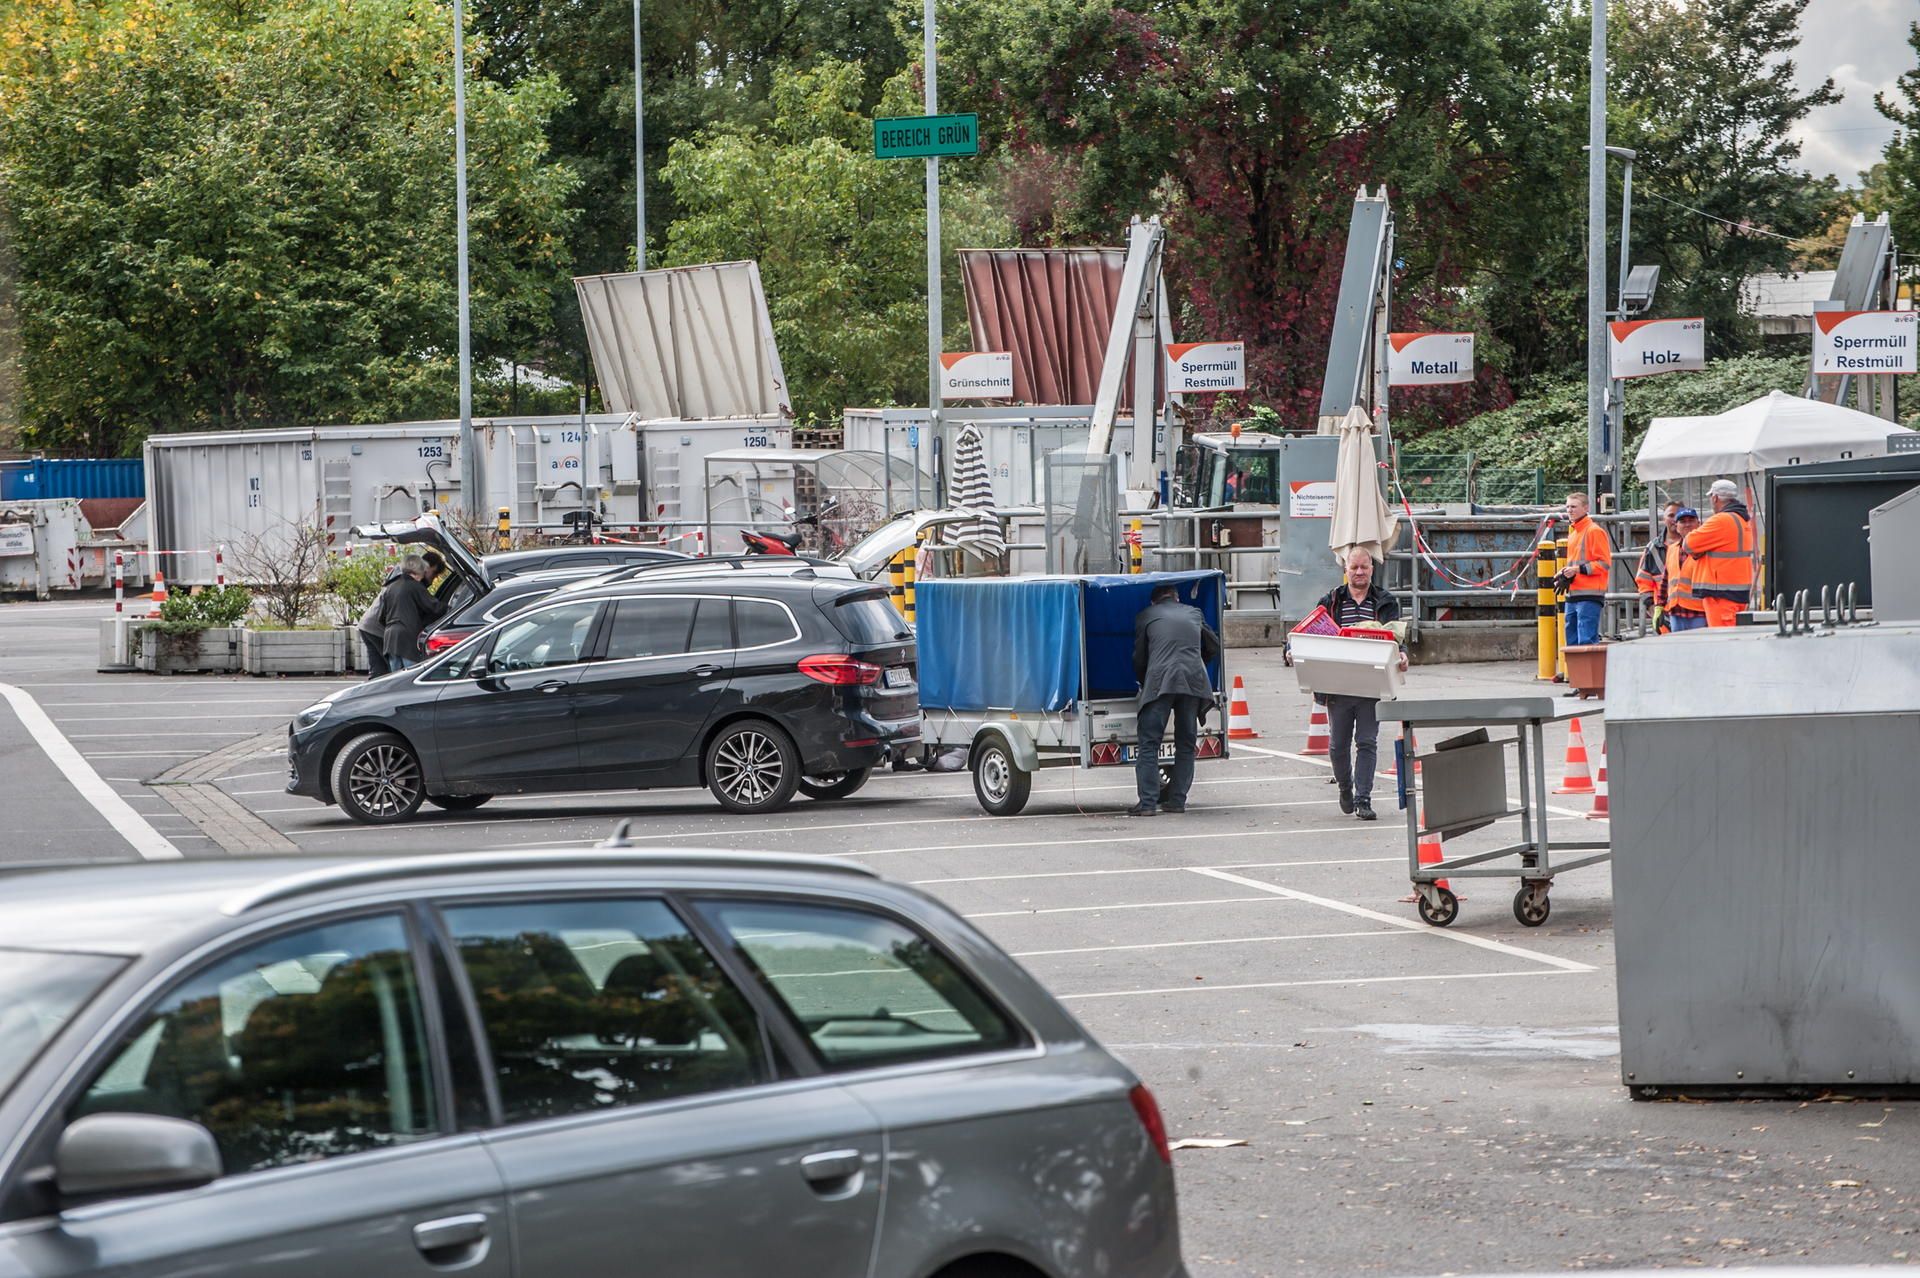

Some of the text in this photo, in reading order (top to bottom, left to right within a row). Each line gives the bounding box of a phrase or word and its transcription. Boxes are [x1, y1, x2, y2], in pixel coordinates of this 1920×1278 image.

[882, 122, 970, 148] BEREICH GRÜN
[1683, 321, 1702, 329] avea
[1894, 314, 1915, 323] avea
[1834, 335, 1907, 351] Sperrmüll
[1642, 350, 1681, 365] Holz
[1837, 355, 1903, 368] Restmüll
[1181, 361, 1237, 374] Sperrmüll
[1411, 361, 1458, 375] Metall
[949, 378, 1010, 388] Grünschnitt
[1185, 377, 1235, 388] Restmüll
[744, 436, 767, 447] 1250
[417, 446, 442, 458] 1253
[551, 456, 580, 469] avea
